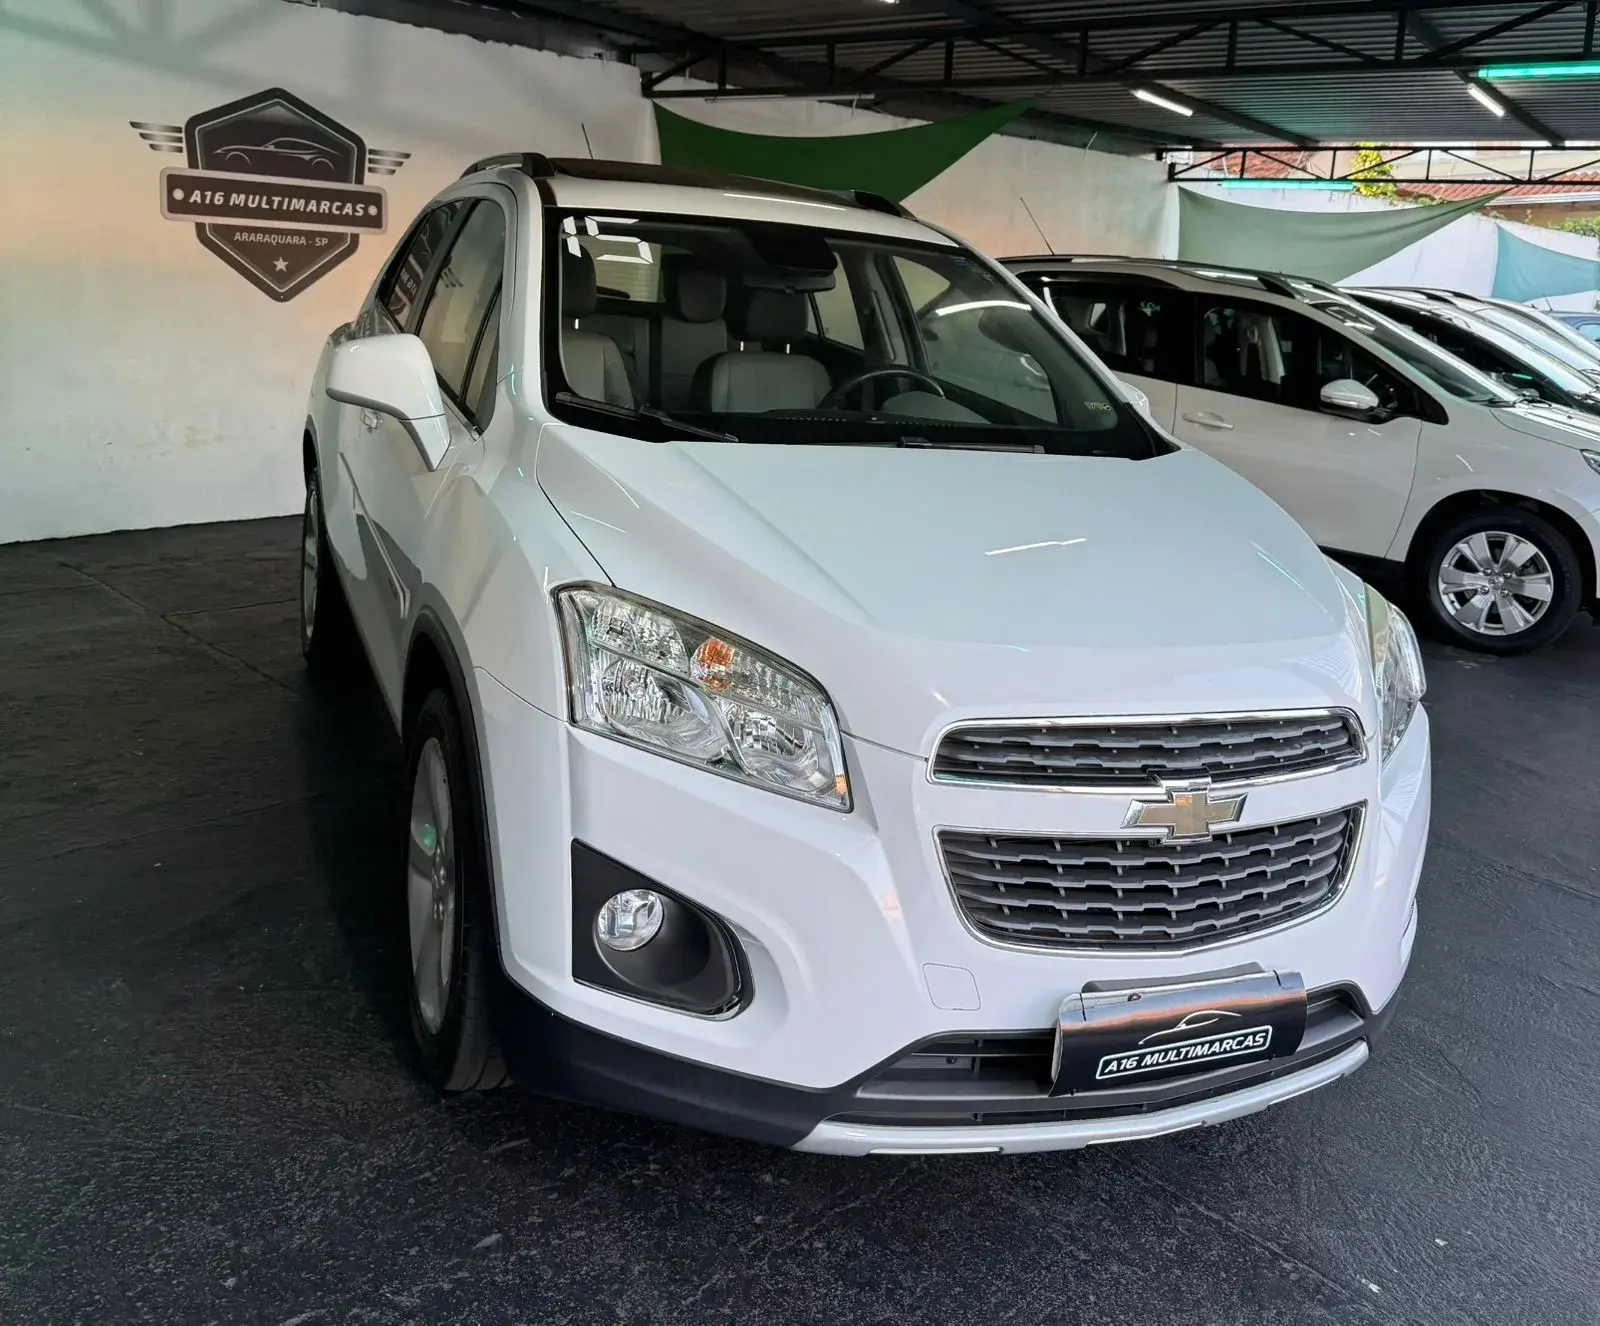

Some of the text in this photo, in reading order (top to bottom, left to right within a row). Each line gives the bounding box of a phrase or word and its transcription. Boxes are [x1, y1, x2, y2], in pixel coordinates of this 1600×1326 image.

[189, 190, 366, 217] A16 MULTIMARCAS
[233, 231, 307, 246] ARARAQUARA
[314, 236, 329, 247] SP
[562, 215, 654, 265] 15
[1103, 1032, 1266, 1073] A16 MULTIMARCAS
